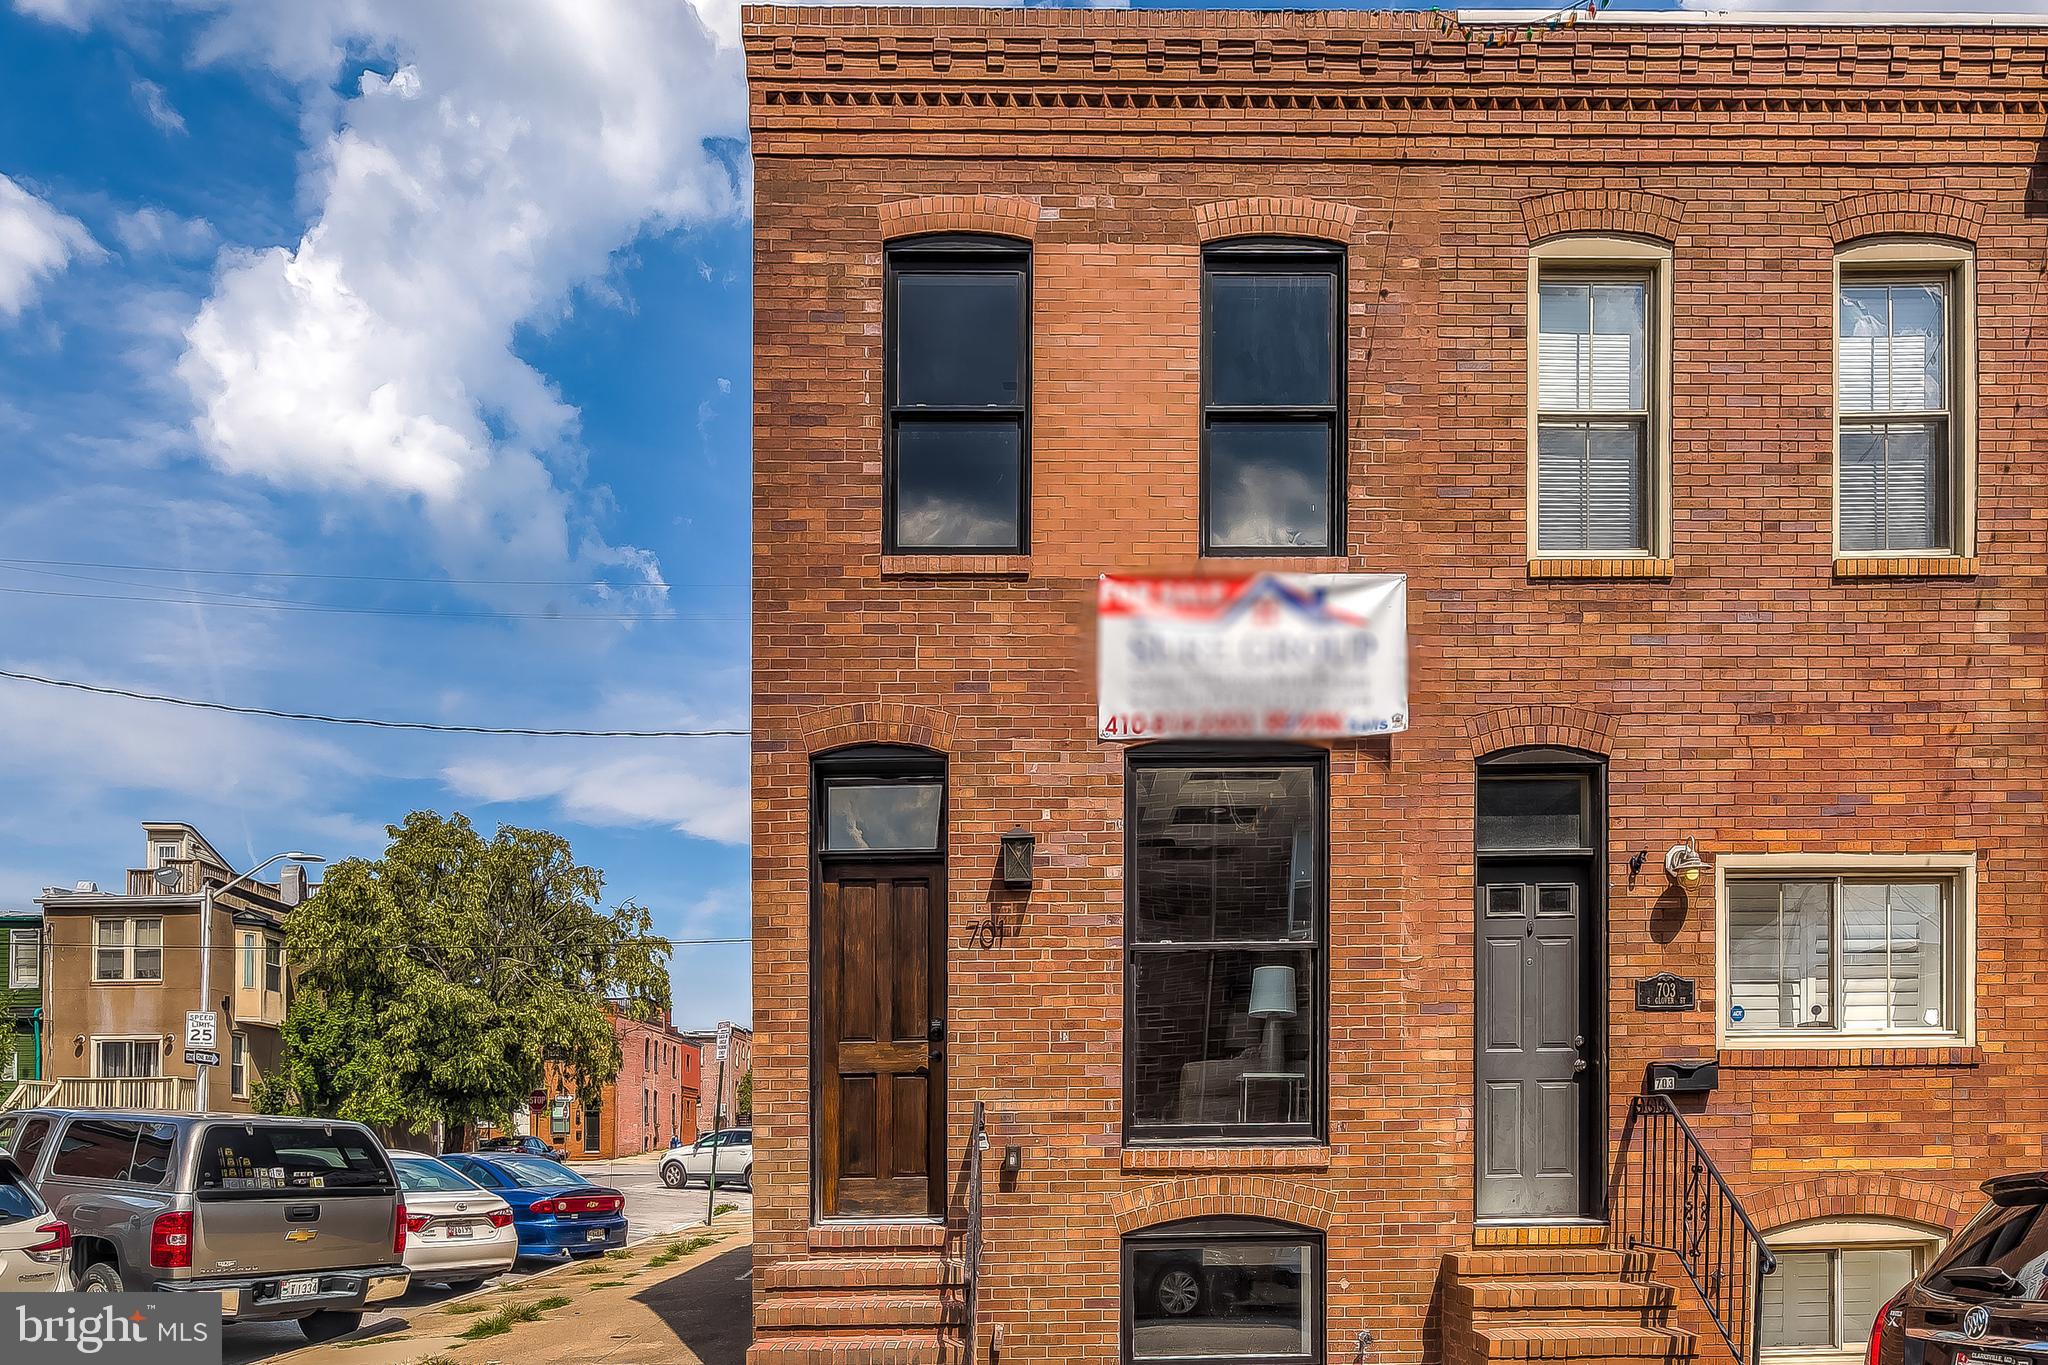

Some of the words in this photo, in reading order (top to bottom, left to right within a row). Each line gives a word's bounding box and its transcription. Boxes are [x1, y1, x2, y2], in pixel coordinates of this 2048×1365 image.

[966, 919, 1004, 949] 701
[1656, 982, 1676, 997] 703
[190, 1029, 212, 1041] 25
[1655, 1077, 1675, 1090] 703
[529, 1096, 547, 1105] STOP
